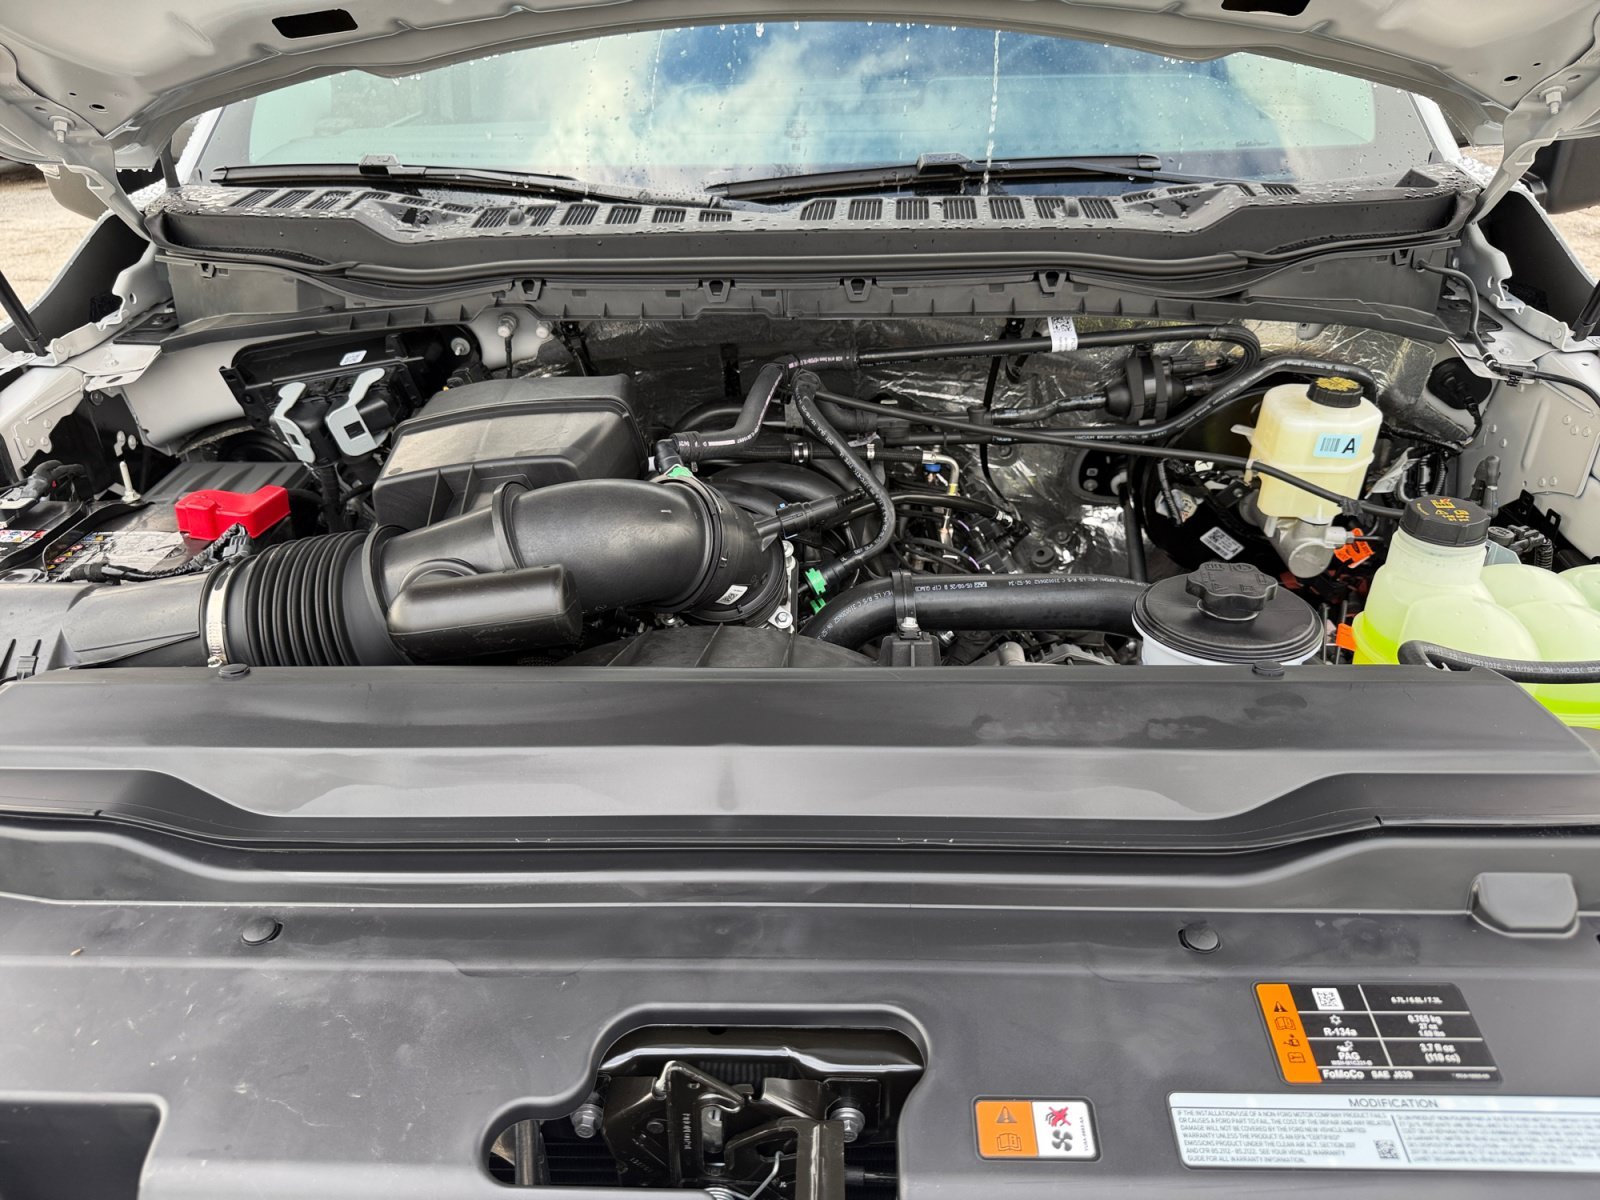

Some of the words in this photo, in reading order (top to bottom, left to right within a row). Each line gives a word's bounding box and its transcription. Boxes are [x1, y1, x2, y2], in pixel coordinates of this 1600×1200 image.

[1341, 437, 1356, 454] A
[1323, 1027, 1358, 1037] R-134a
[1338, 1051, 1361, 1061] PAG
[1322, 1069, 1365, 1080] FoMoCo
[1371, 1070, 1391, 1080] SAE
[1347, 1097, 1439, 1110] MODIFICATION
